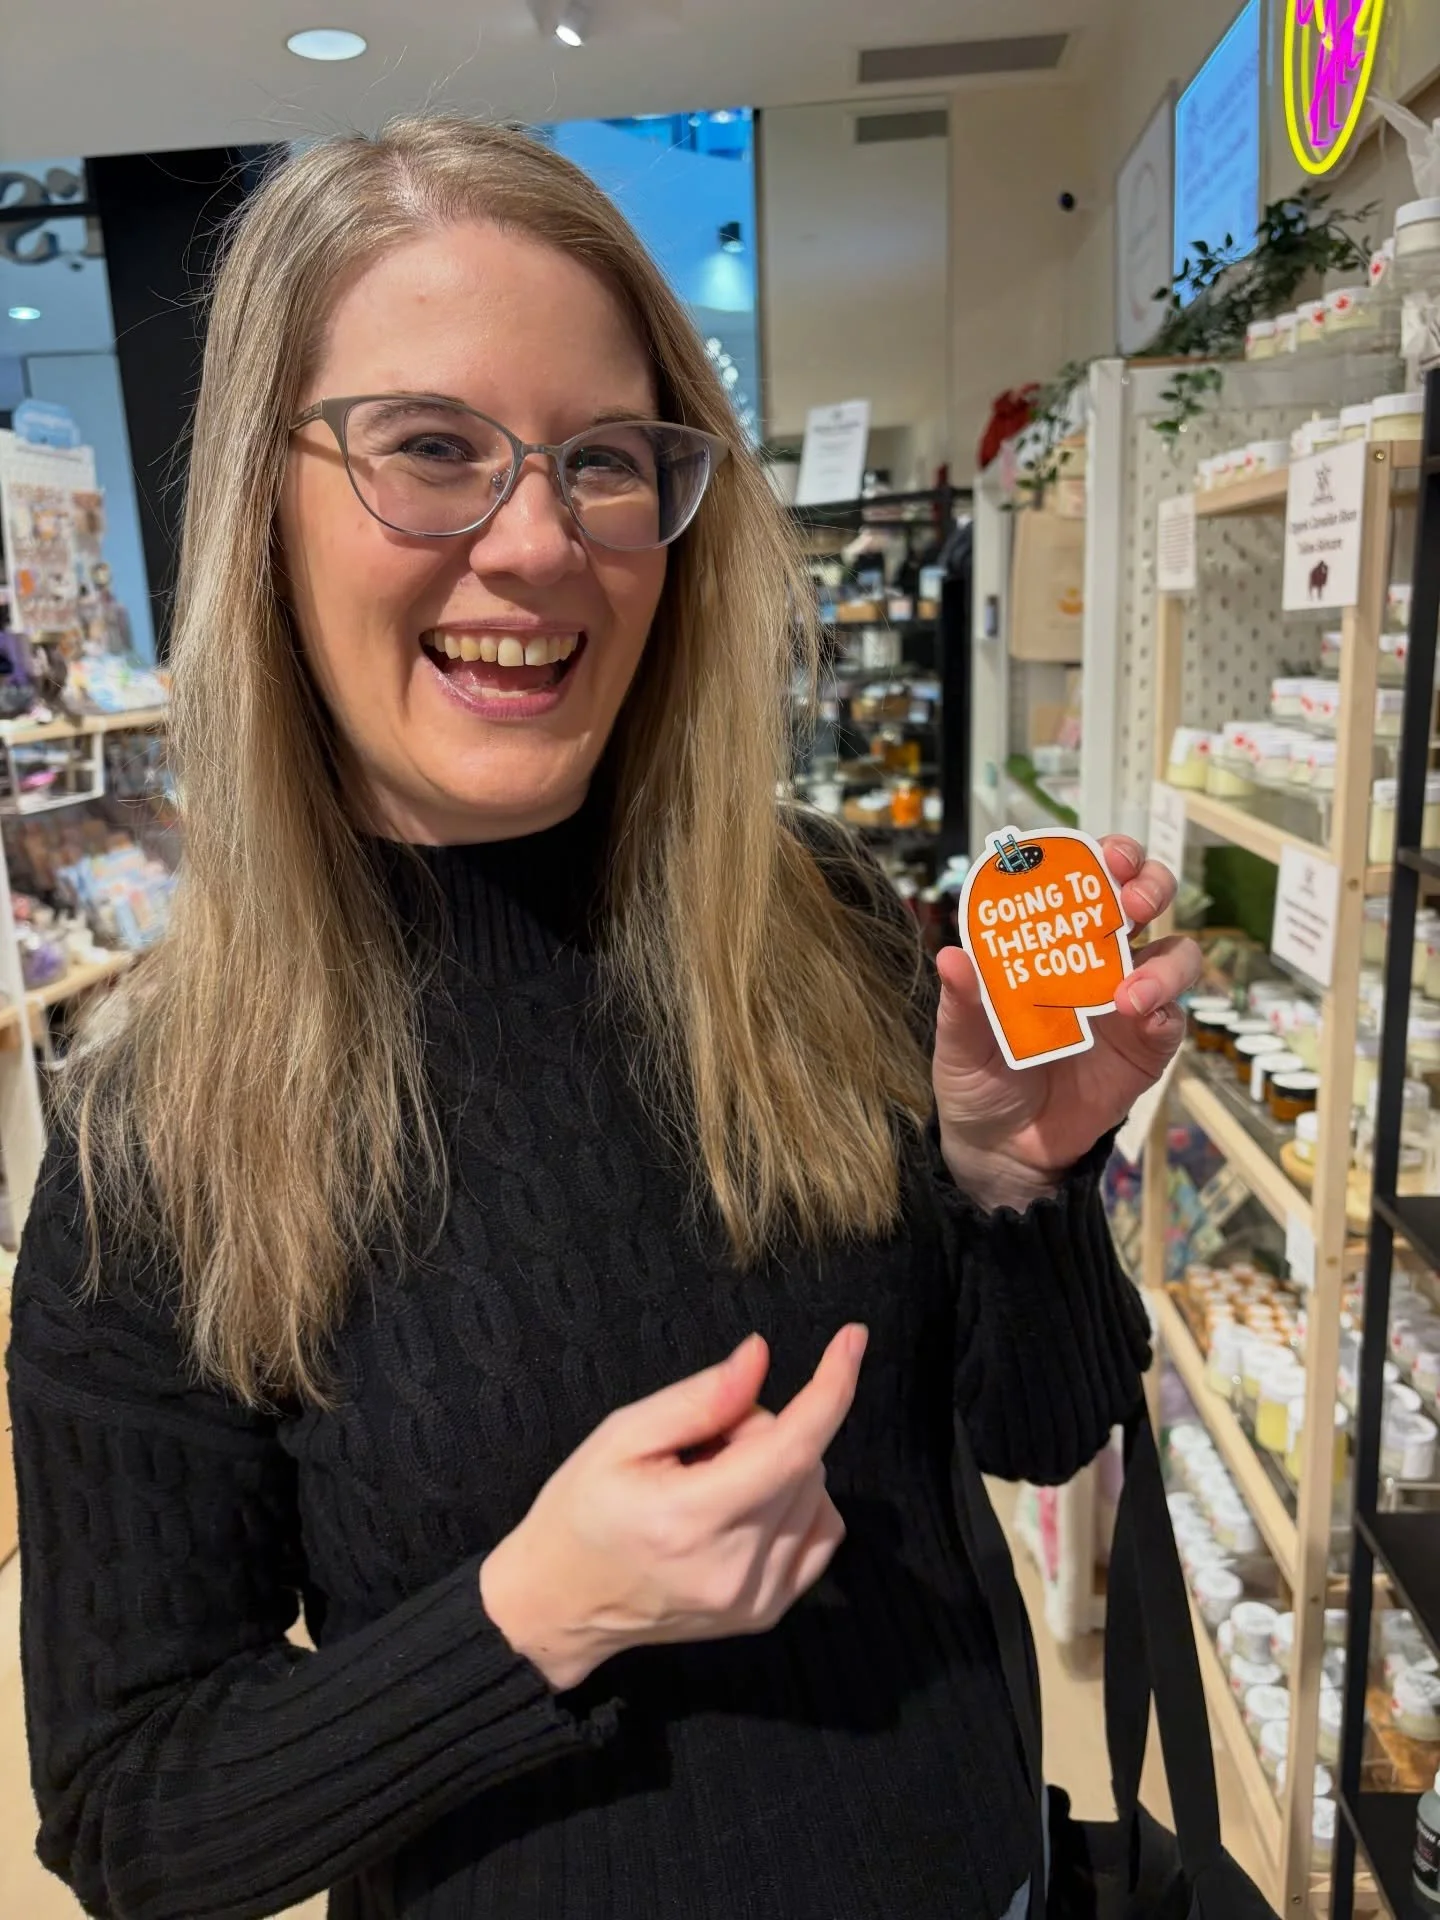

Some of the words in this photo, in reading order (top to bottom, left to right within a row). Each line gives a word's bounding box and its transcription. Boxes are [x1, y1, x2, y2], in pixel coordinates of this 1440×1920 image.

[1064, 871, 1101, 903] TO
[980, 903, 1104, 958] THERAPY
[1034, 941, 1105, 977] COOL
